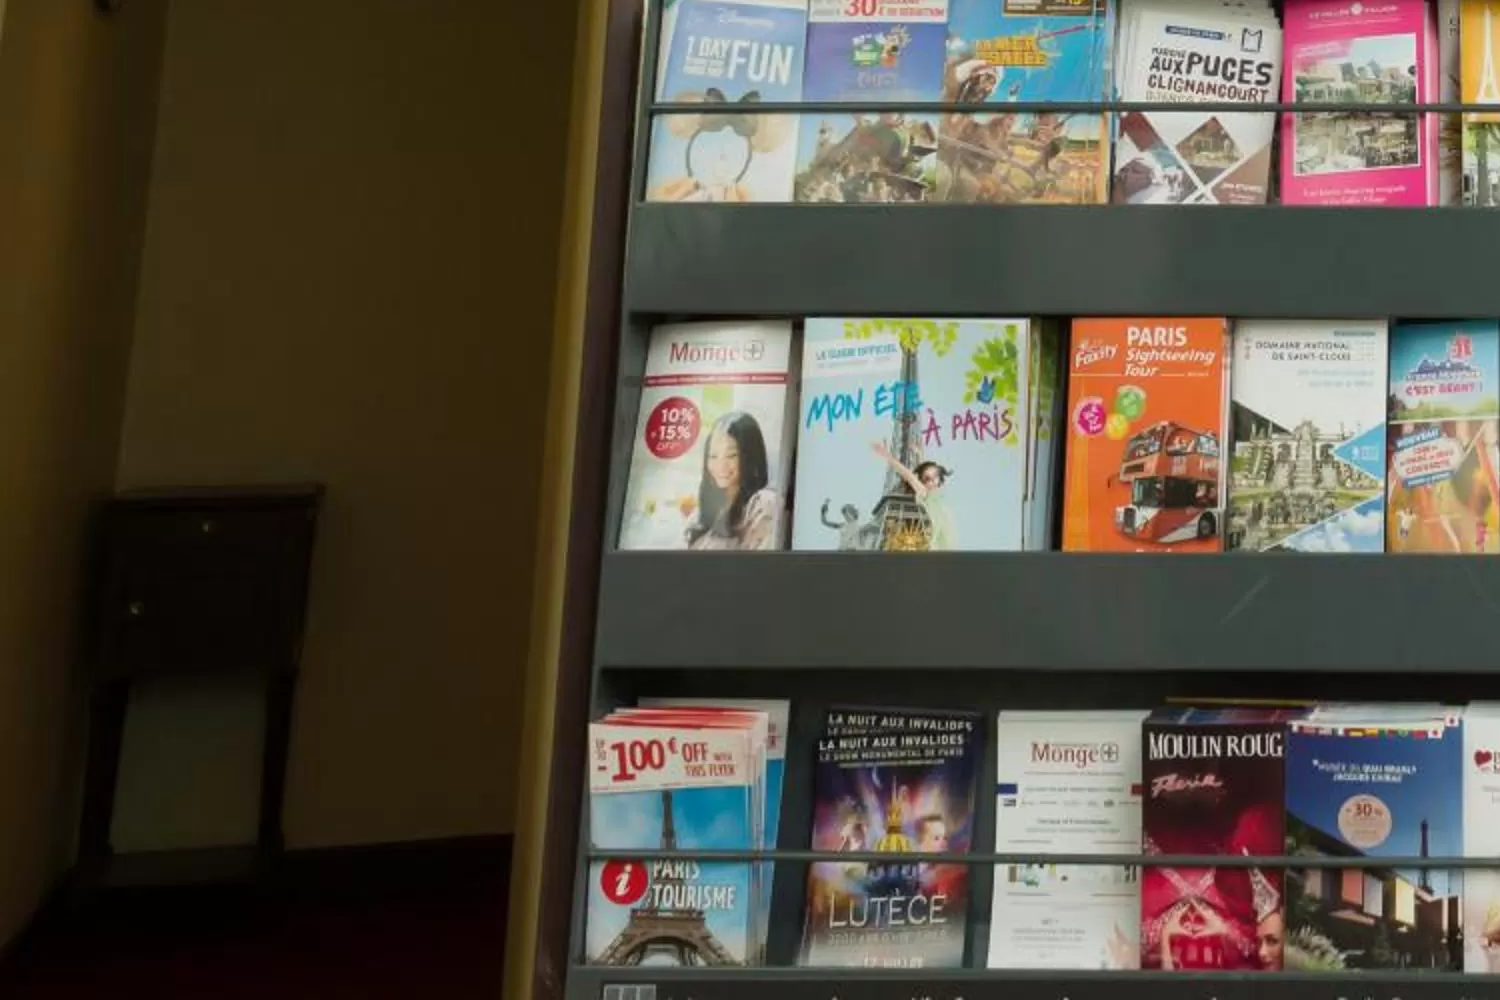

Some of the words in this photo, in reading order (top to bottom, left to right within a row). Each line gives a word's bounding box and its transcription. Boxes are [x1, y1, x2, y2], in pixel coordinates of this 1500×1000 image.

[727, 40, 794, 86] FUN
[1150, 55, 1184, 75] AUX
[1185, 51, 1274, 86] PUCES
[1147, 74, 1270, 103] CLIGNANCOURT
[1126, 326, 1188, 347] PARIS
[1125, 348, 1216, 365] Sightseeing
[1124, 363, 1158, 377] Tour
[661, 407, 695, 424] 10%
[806, 388, 864, 433] MON
[658, 425, 691, 441] 15%
[921, 408, 942, 447] À
[828, 713, 843, 725] LA
[848, 714, 877, 727] NUIT
[881, 715, 905, 728] AUX
[682, 742, 709, 763] OFF
[819, 738, 837, 750] LA
[839, 736, 868, 749] NUIT
[872, 734, 896, 747] AUX
[900, 732, 965, 746] INVALIDES
[1149, 732, 1222, 760] MOULIN
[1226, 732, 1282, 758] ROUG
[1031, 741, 1100, 767] Monge
[652, 860, 700, 880] PARIS
[650, 883, 737, 910] TOURISME
[829, 887, 948, 929] LUTÈCE
